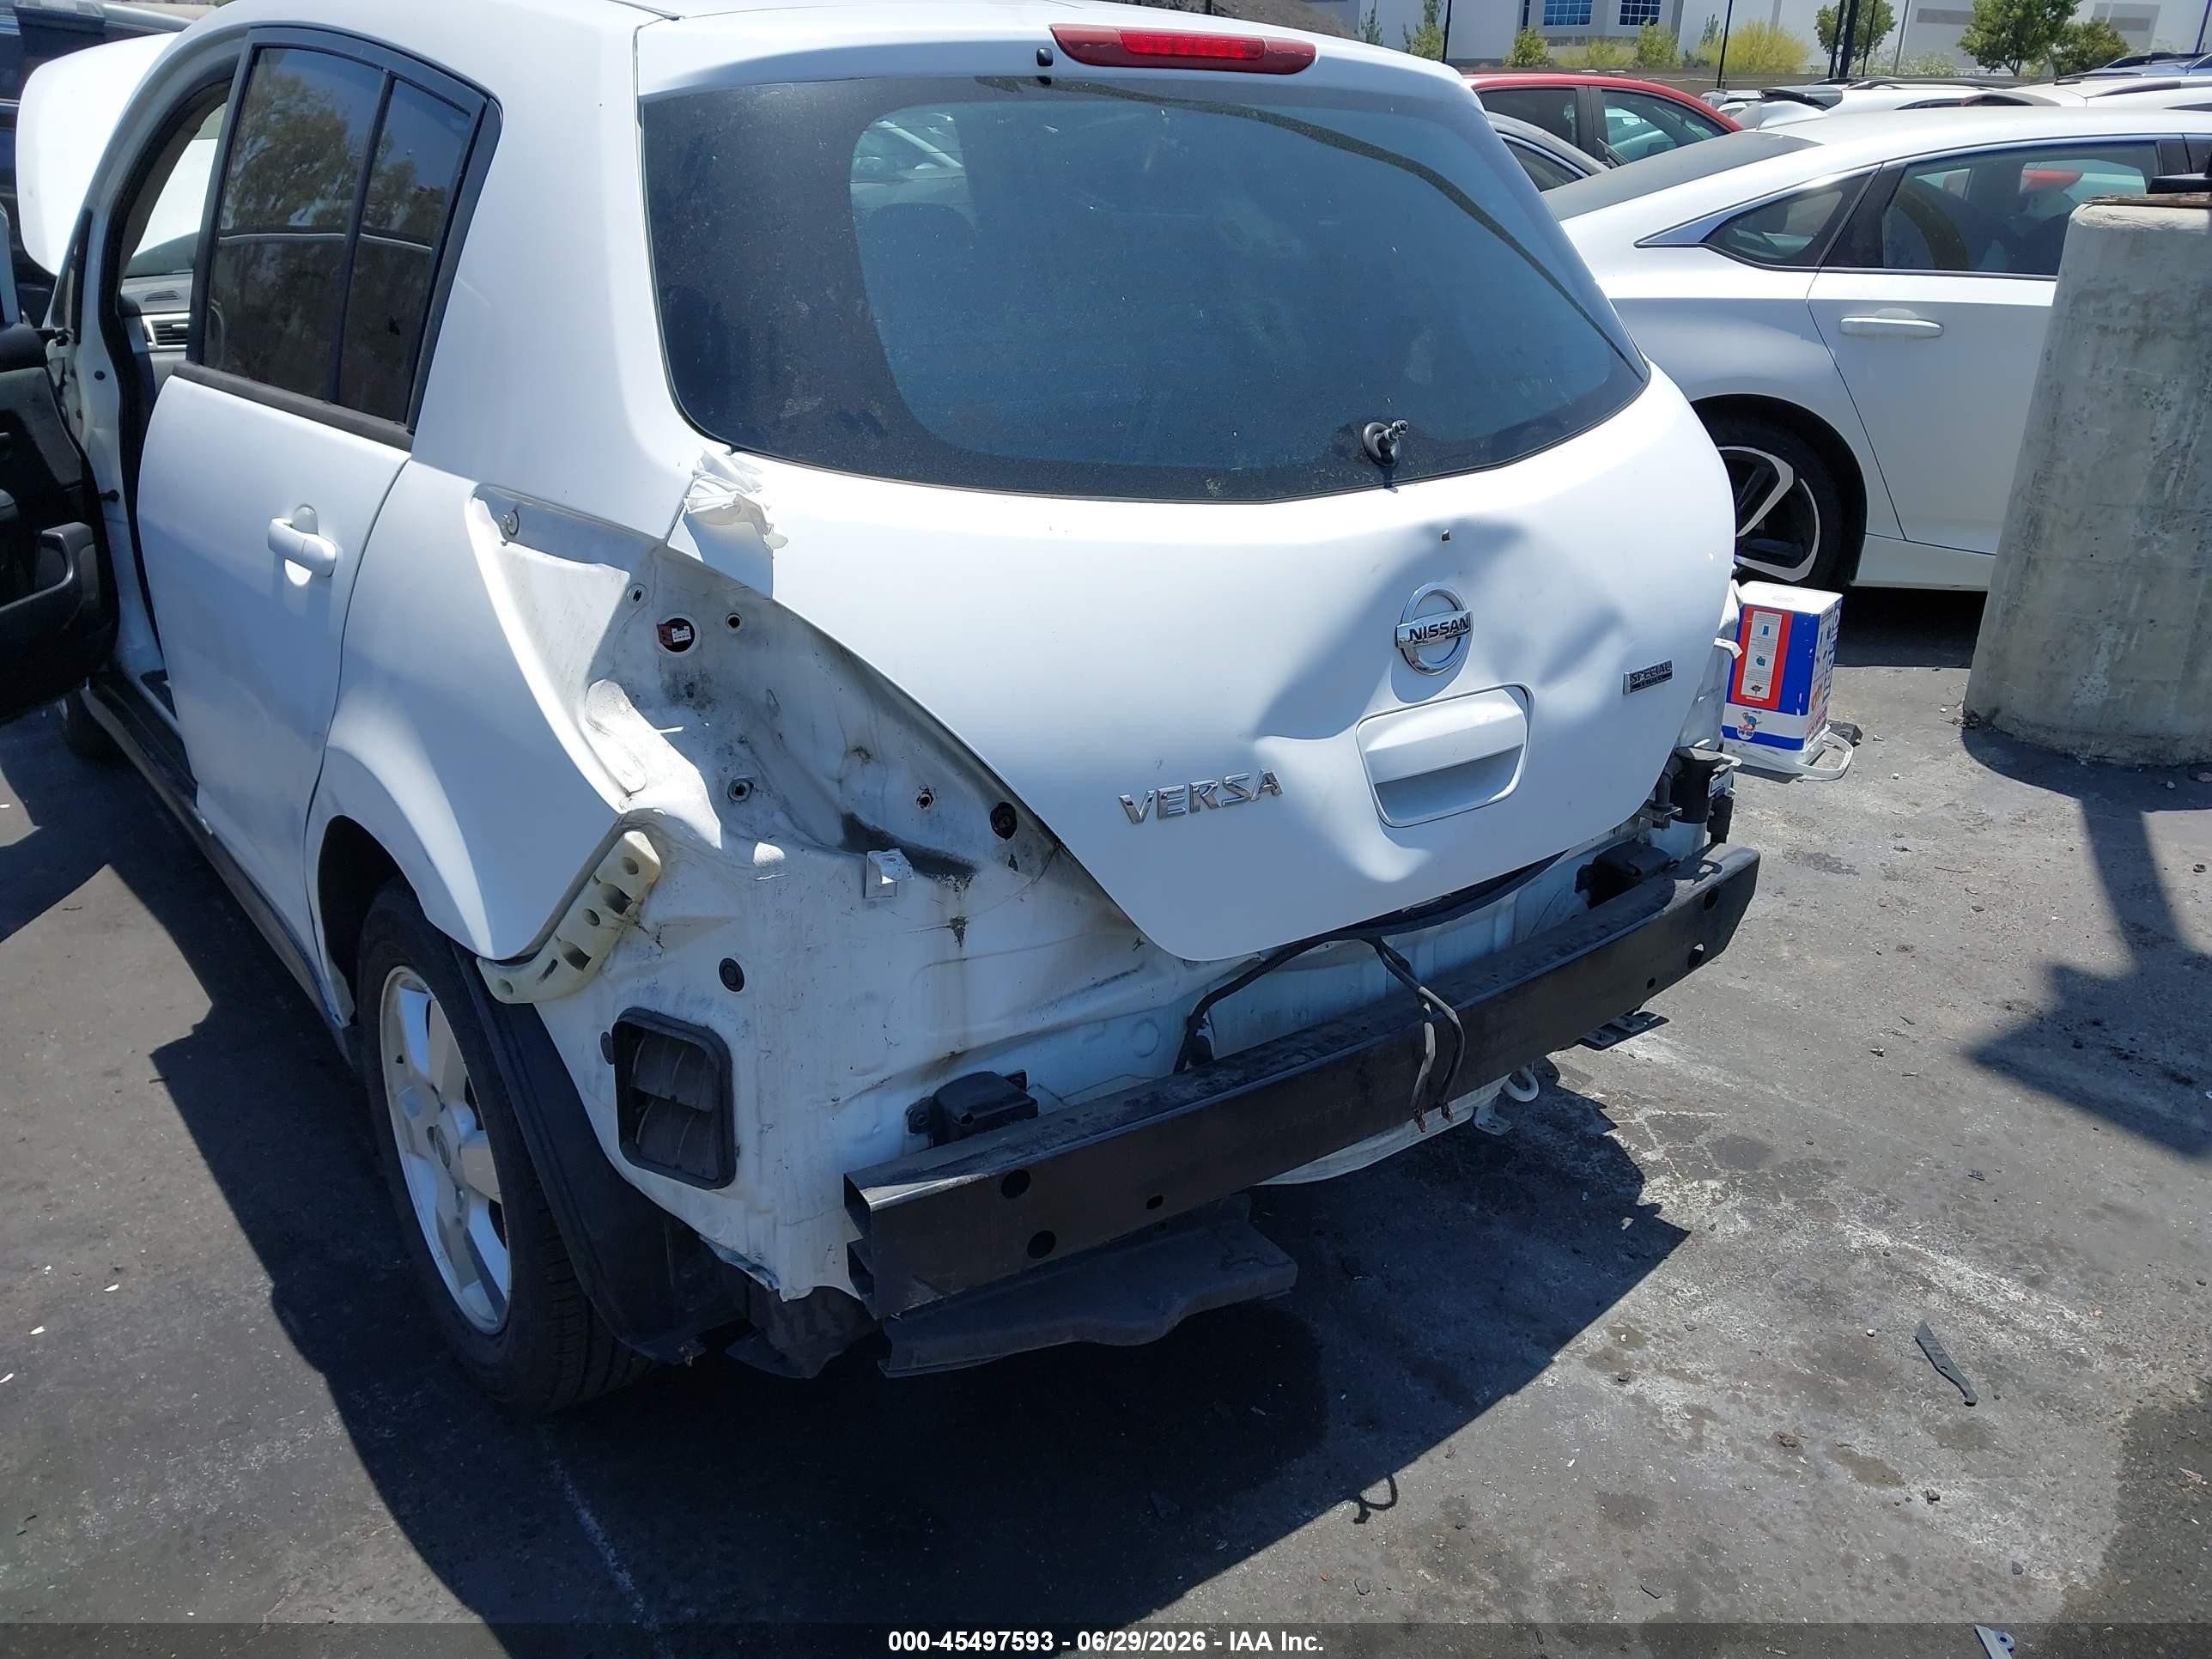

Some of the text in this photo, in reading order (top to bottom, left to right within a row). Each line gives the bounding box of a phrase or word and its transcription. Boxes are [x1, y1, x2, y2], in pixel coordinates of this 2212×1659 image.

[1409, 616, 1469, 642] NISSAN
[1631, 661, 1672, 685] SPECIAL
[1119, 769, 1284, 824] VERSA
